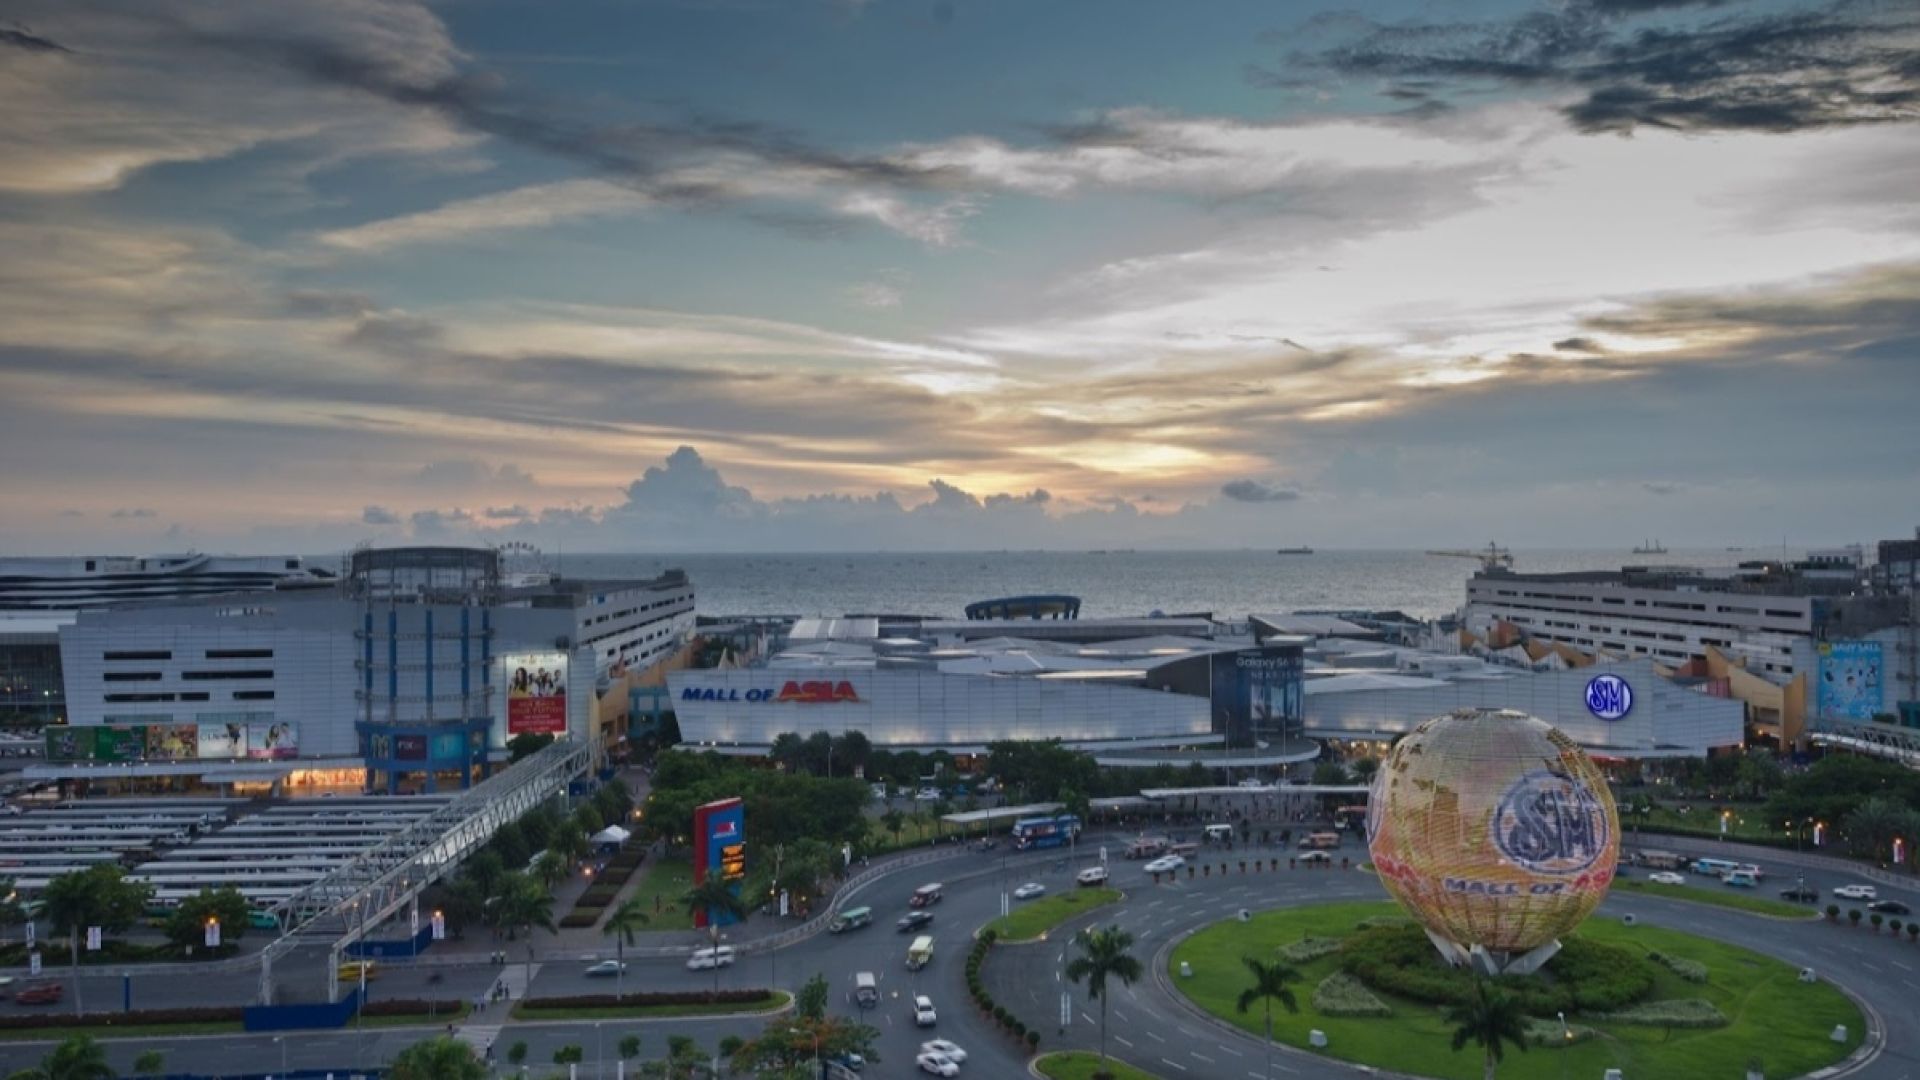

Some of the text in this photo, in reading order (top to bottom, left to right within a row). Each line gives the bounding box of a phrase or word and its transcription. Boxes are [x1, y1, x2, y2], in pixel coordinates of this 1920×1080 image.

[1236, 656, 1275, 669] Galaxy
[682, 680, 861, 703] MALL OF ASIA
[1588, 678, 1626, 715] SM
[1506, 786, 1597, 862] SM
[1444, 877, 1519, 895] MALL
[1529, 881, 1566, 895] OF
